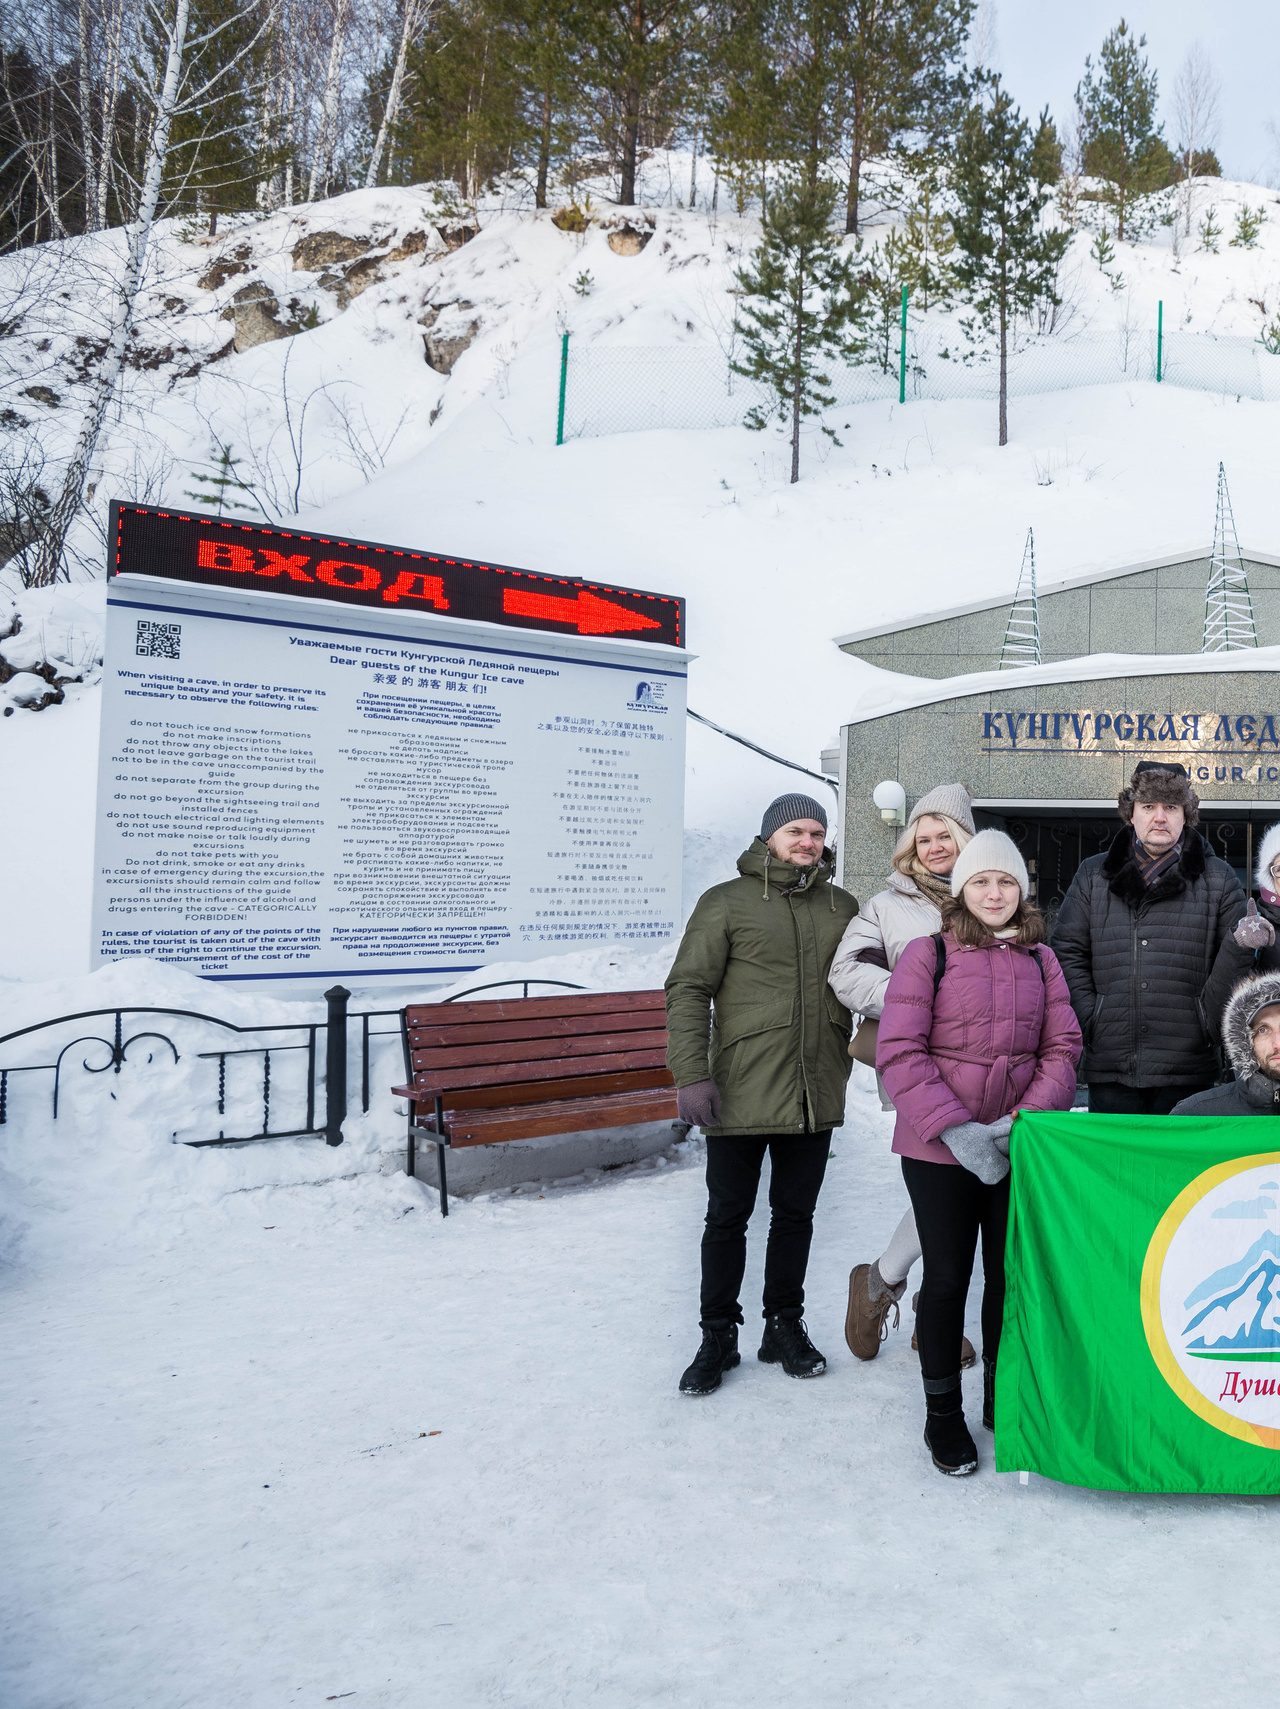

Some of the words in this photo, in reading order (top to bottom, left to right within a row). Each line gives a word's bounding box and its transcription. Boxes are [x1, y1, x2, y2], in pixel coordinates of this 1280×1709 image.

[199, 540, 450, 610] ВХОД
[289, 636, 362, 653] Уважаемые
[365, 647, 397, 657] гости
[400, 650, 465, 665] Кунгурской
[468, 658, 515, 671] Ледяной
[518, 666, 559, 676] пещеры
[330, 655, 358, 666] Dear
[361, 660, 400, 671] guests
[403, 664, 416, 672] of
[418, 666, 437, 675] the
[440, 668, 479, 680] Kungur
[482, 673, 498, 682] Ice
[501, 677, 525, 685] cave
[117, 670, 146, 679] When
[148, 674, 185, 684] visiting
[273, 686, 312, 695] preserve
[140, 682, 174, 690] unique
[177, 684, 210, 695] beauty
[255, 693, 286, 701] safety,
[373, 672, 397, 685] 亲爱
[401, 676, 414, 687] 的
[417, 677, 441, 690] 游客
[445, 680, 468, 693] 朋友
[472, 683, 487, 694] 们!
[124, 689, 175, 700] necessary
[190, 695, 228, 704] observe
[248, 699, 292, 710] following
[356, 699, 406, 708] сохранения
[419, 705, 467, 714] уникальной
[362, 691, 379, 699] При
[381, 694, 428, 703] посещении
[429, 699, 464, 707] пещеры,
[363, 713, 409, 722] соблюдать
[411, 717, 458, 726] следующие
[460, 721, 494, 729] правила:
[393, 708, 451, 719] безопасности,
[453, 715, 501, 724] необходимо
[162, 730, 175, 738] do
[226, 736, 282, 745] inscriptions
[165, 722, 194, 730] touch
[260, 728, 311, 739] formations
[982, 713, 1201, 748] КУНГУРСКАЯ
[185, 913, 247, 921] FORBIDDEN!
